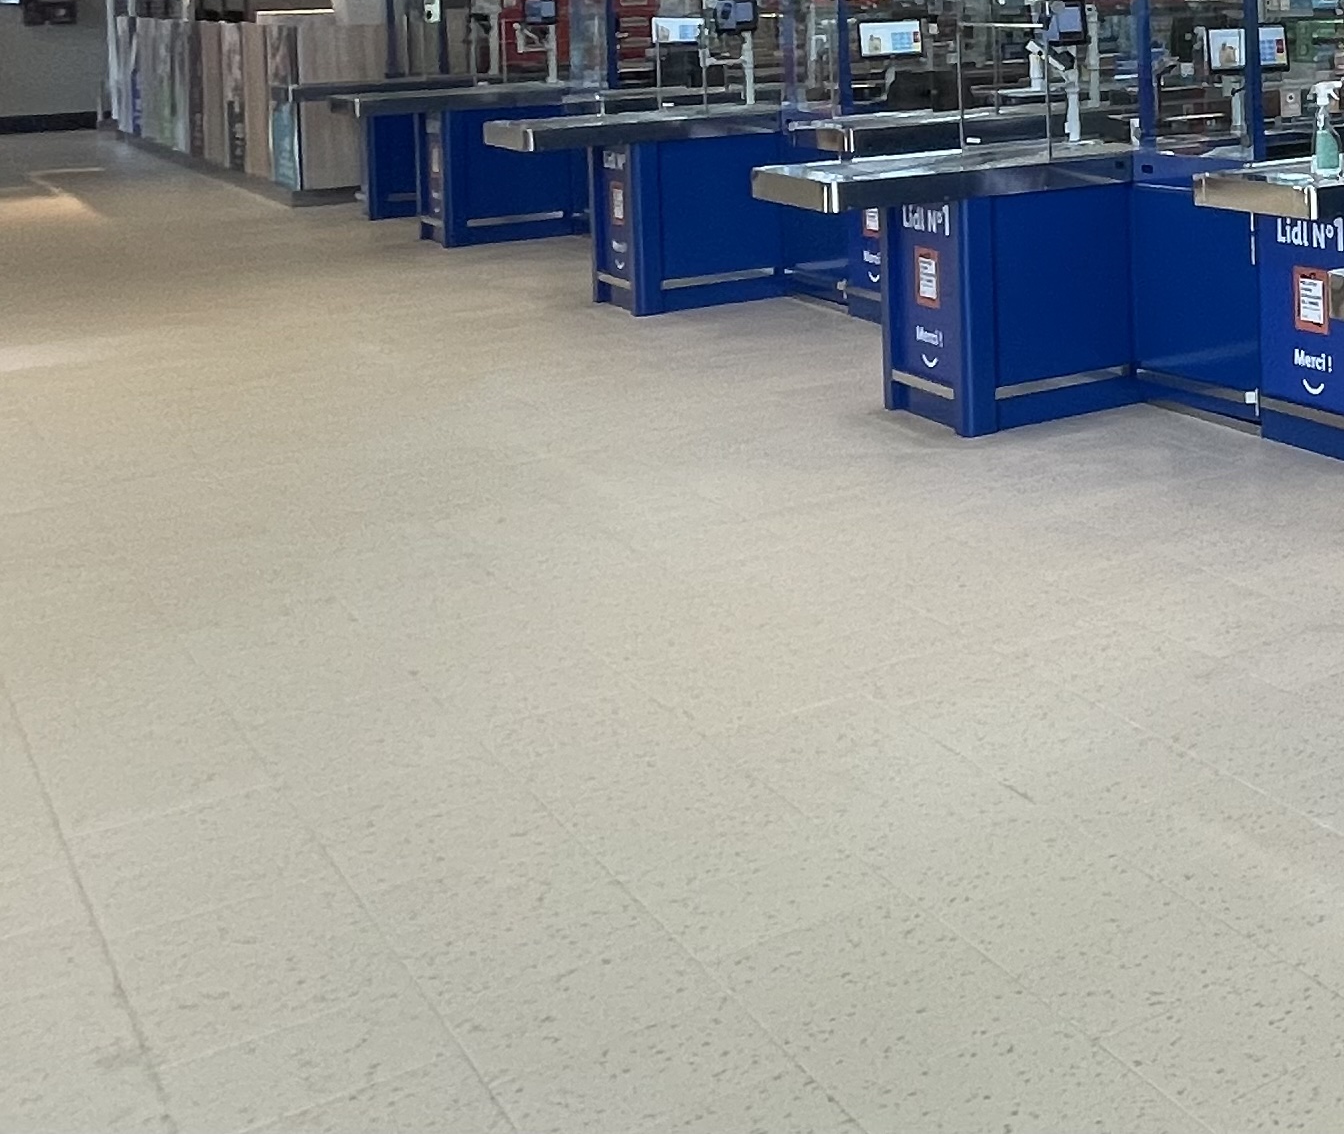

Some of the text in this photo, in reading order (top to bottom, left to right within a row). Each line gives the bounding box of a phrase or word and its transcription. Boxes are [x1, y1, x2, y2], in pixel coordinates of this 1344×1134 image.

[1277, 217, 1344, 252] Lidl N°1
[1294, 348, 1326, 371] Merci
